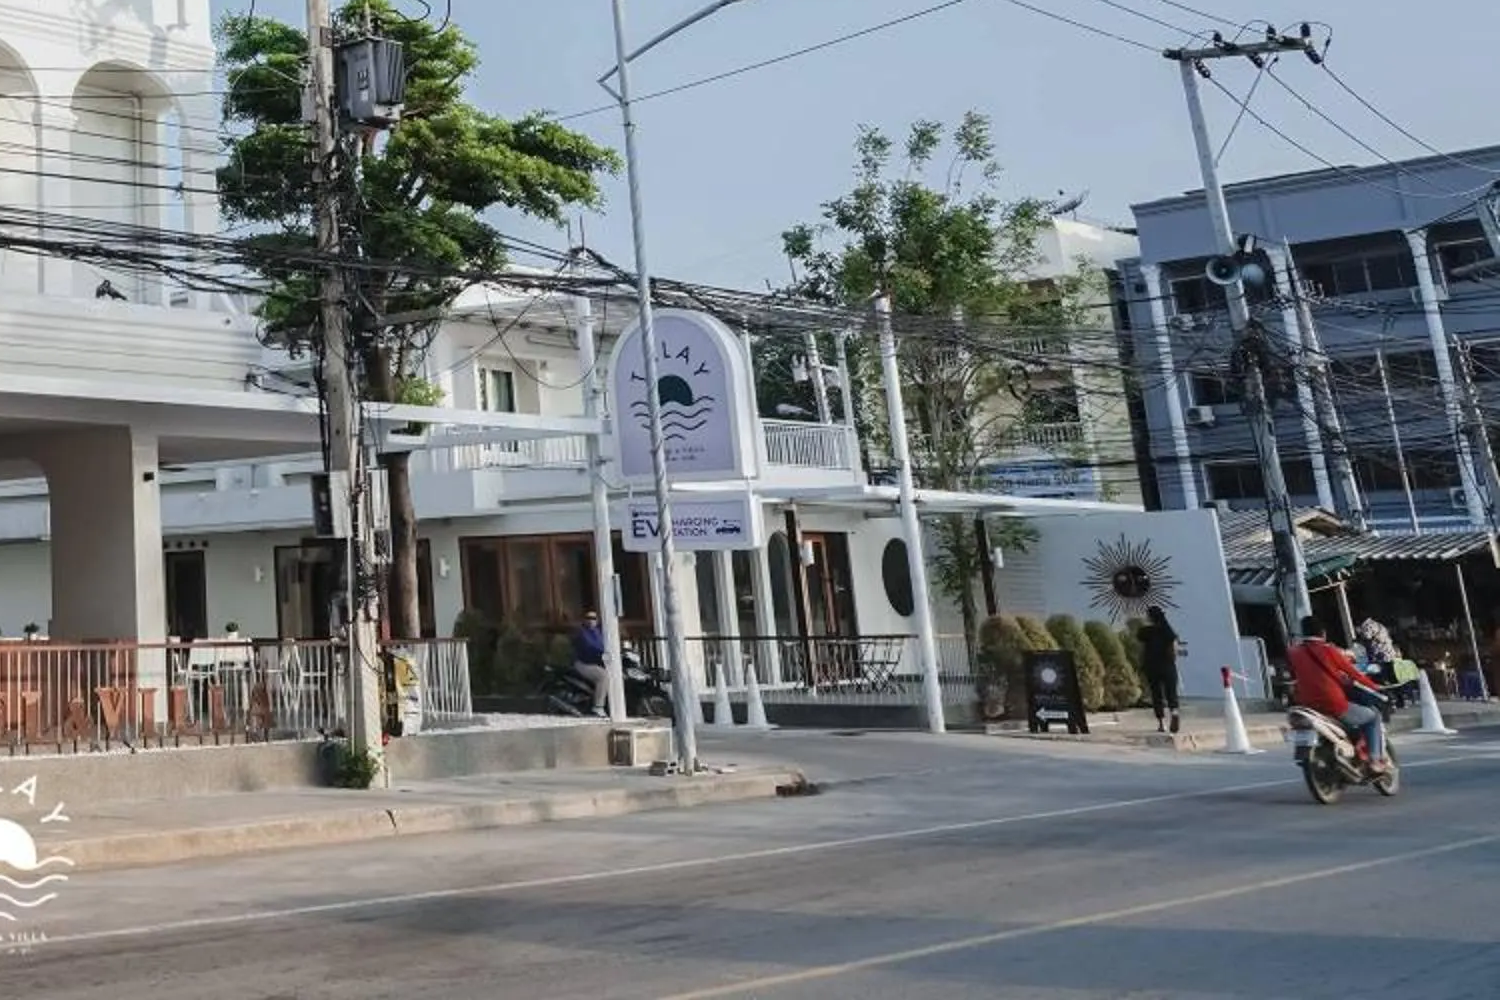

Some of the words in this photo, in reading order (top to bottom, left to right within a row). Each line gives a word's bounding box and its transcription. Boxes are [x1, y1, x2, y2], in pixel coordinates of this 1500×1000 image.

[630, 341, 710, 381] TLAY
[671, 517, 719, 527] HARGING
[95, 681, 273, 738] VILLA
